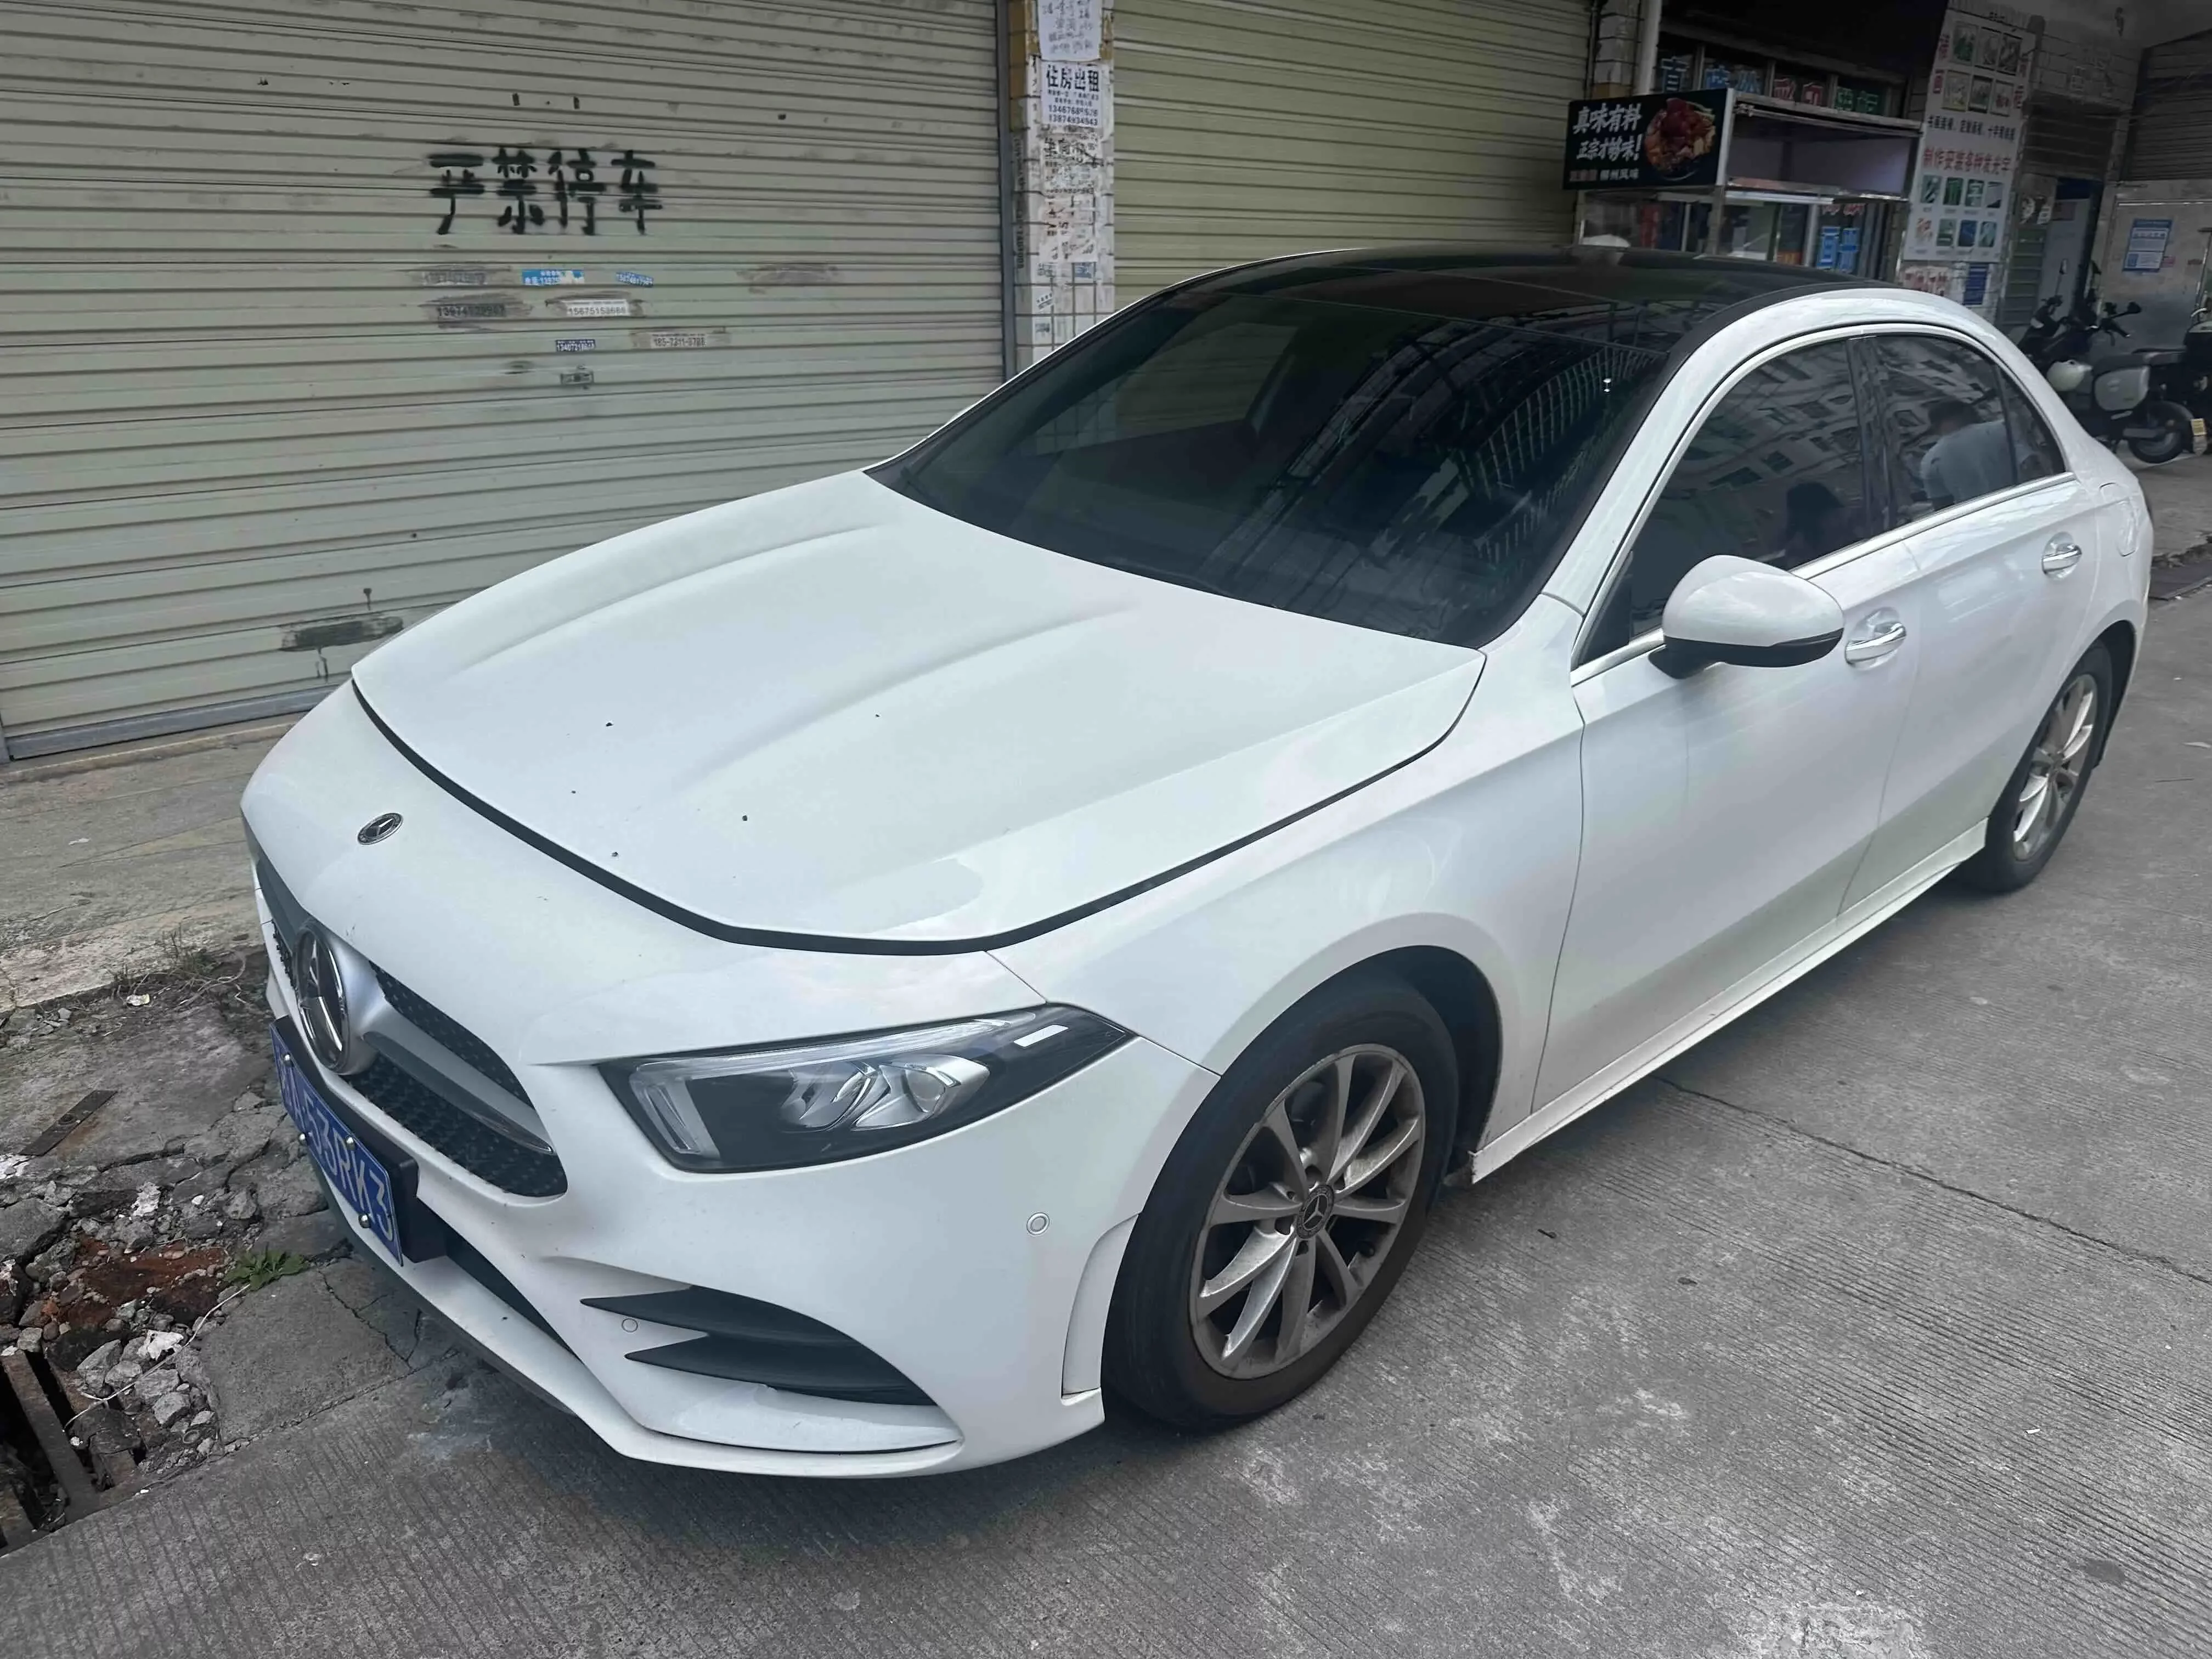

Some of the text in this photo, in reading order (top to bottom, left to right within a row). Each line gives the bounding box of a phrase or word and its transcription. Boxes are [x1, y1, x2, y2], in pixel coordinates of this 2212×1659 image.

[1046, 65, 1099, 92] 住房出租
[1572, 102, 1642, 134] 真味有料
[427, 147, 663, 236] 严禁停车
